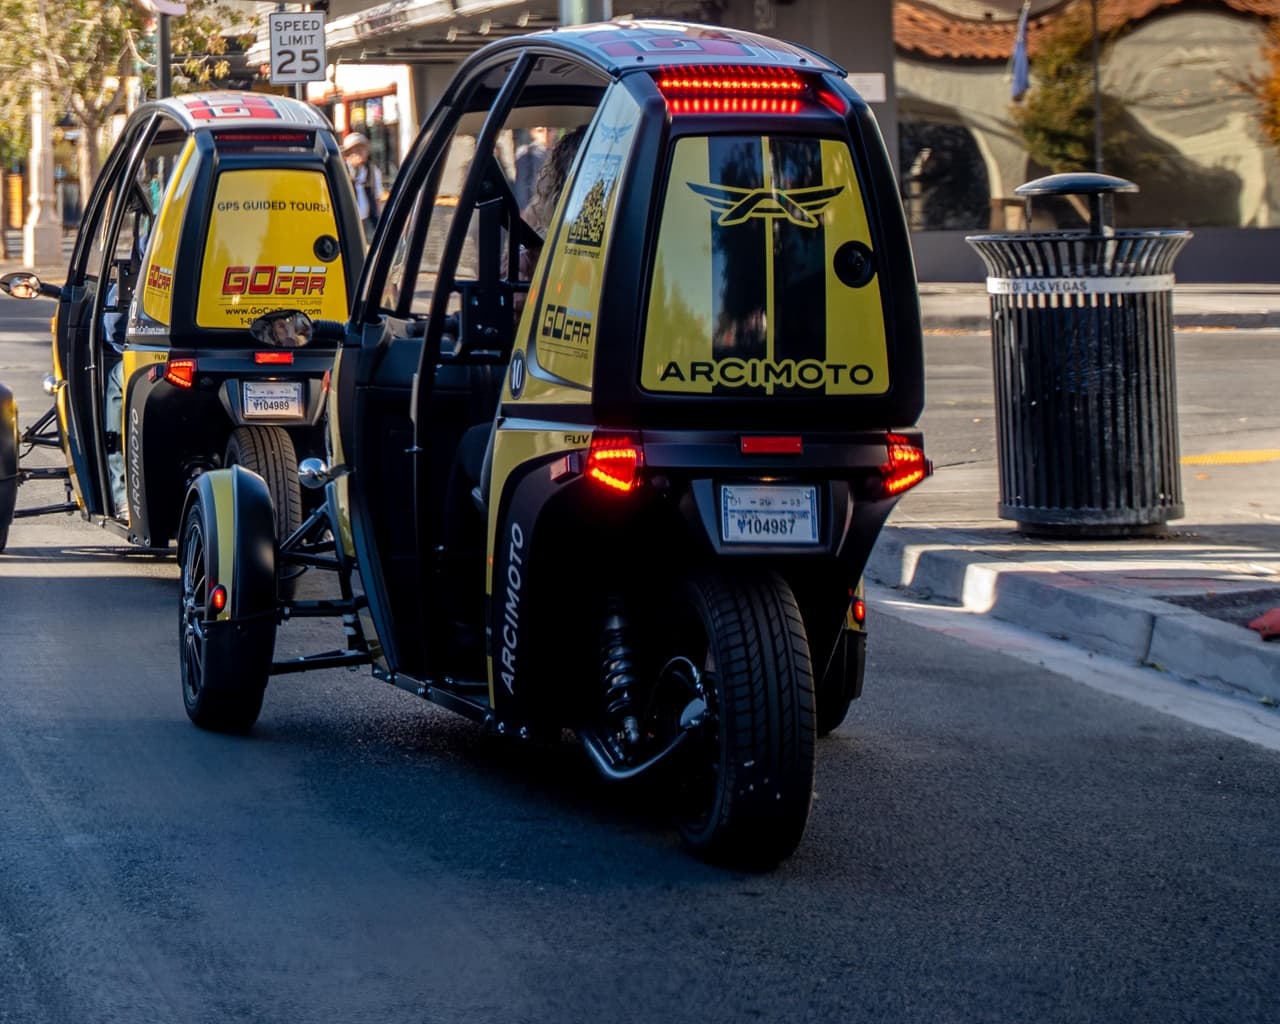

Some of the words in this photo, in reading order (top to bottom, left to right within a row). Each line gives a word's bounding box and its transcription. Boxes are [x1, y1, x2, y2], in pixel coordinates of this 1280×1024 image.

[274, 20, 320, 32] SPEED
[279, 34, 316, 46] LIMIT
[276, 49, 321, 74] 25
[217, 201, 239, 212] GPS
[243, 201, 286, 211] GUIDED
[1026, 281, 1046, 292] LAS
[1048, 280, 1087, 292] VEGAS
[659, 361, 874, 386] ARCIMOTO
[564, 434, 589, 445] FUV
[131, 408, 141, 519] ARCIMOTO
[746, 519, 796, 534] 104987
[501, 522, 525, 696] ARCIMOTO
